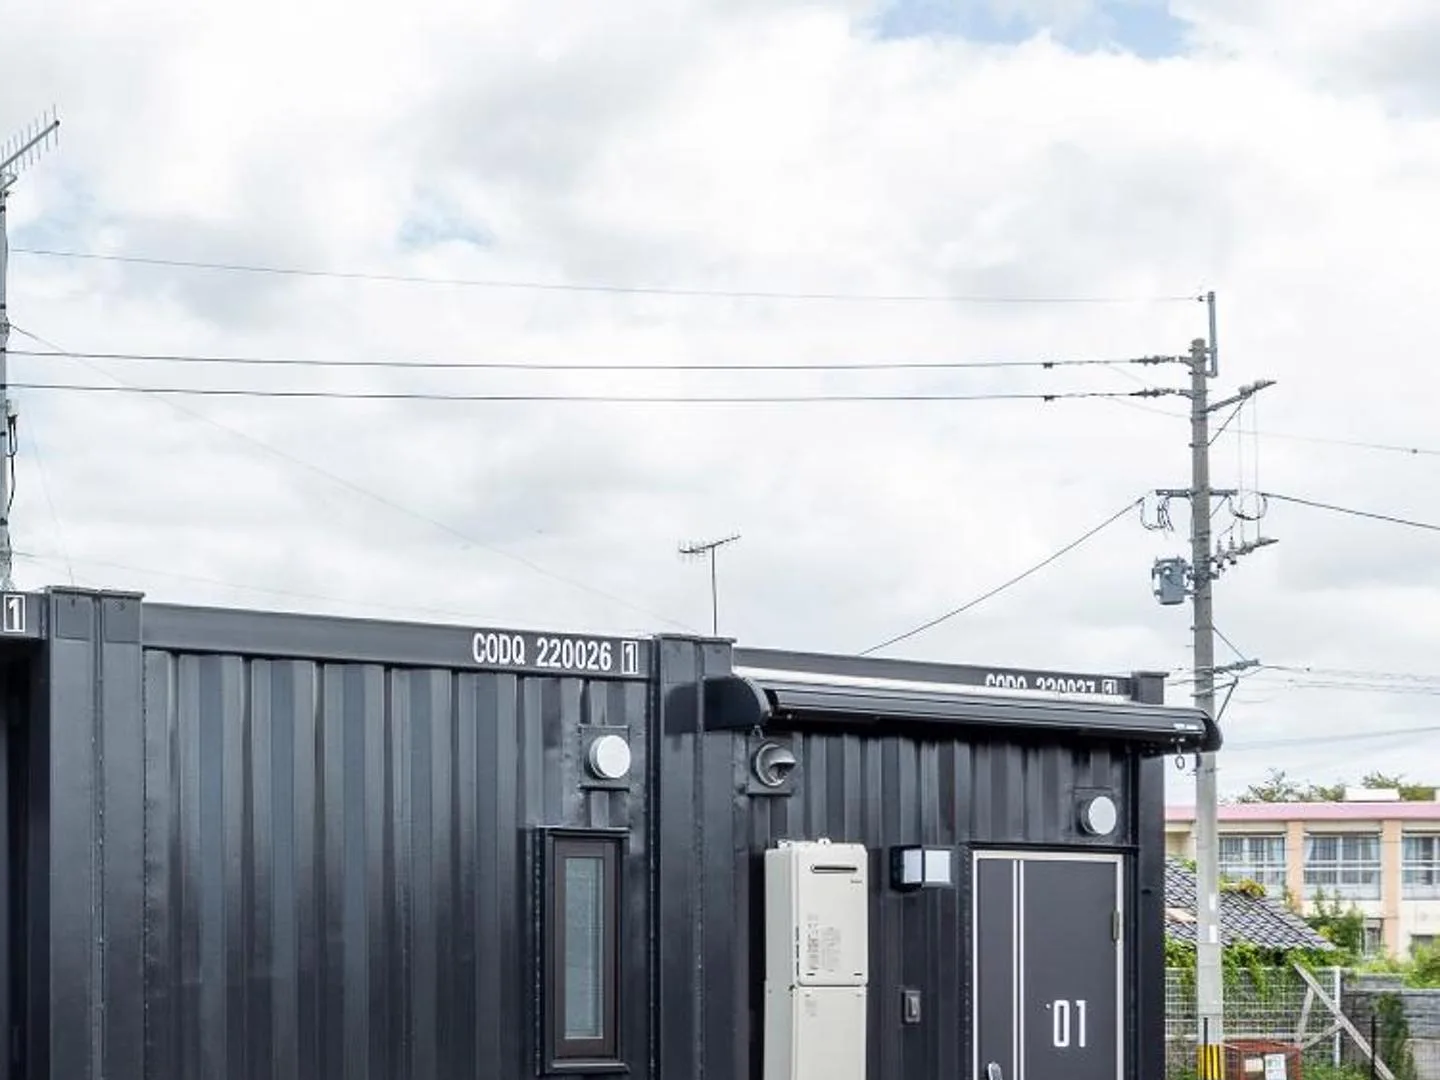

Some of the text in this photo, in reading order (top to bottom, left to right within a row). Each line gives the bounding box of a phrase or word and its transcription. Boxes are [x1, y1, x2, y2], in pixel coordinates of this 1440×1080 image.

[6, 597, 23, 632] 1
[472, 632, 637, 674] CODQ 220026 1
[1054, 1000, 1085, 1047] 01
